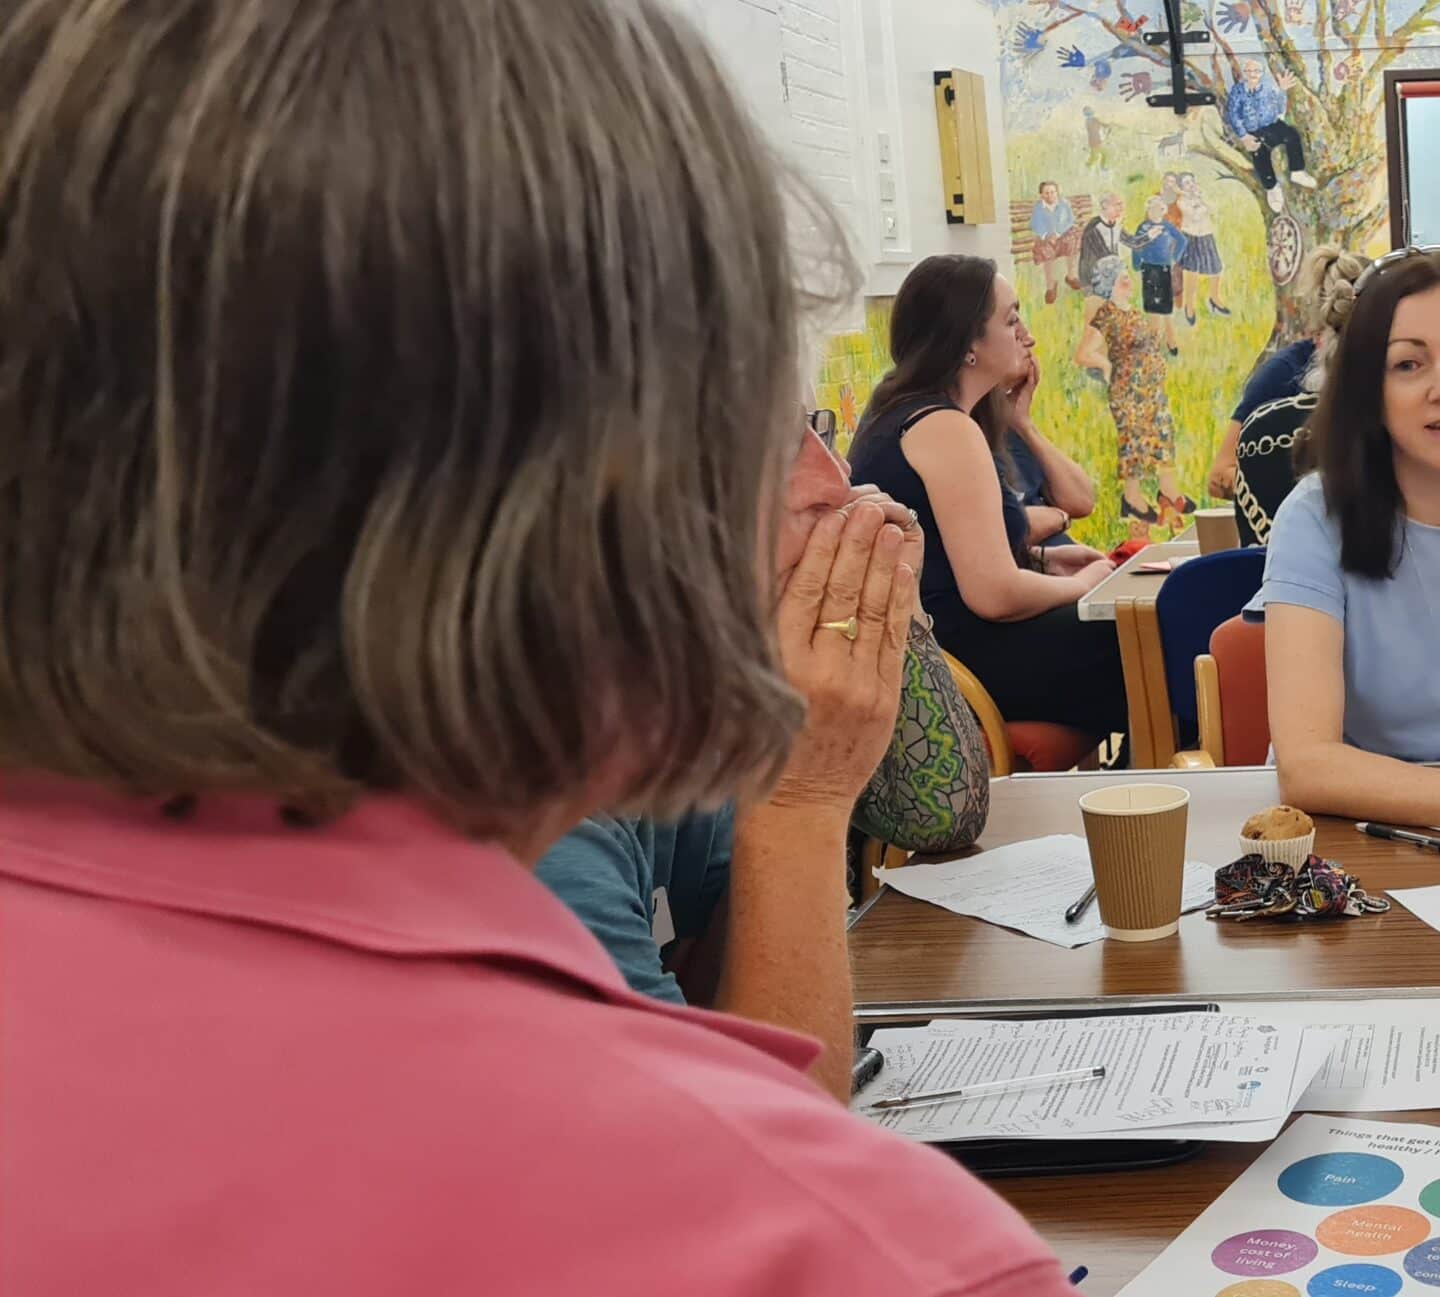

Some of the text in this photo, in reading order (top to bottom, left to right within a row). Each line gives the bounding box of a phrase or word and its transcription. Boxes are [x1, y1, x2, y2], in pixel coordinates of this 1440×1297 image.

[1328, 1128, 1372, 1140] Things
[1376, 1133, 1405, 1143] that
[1407, 1137, 1431, 1147] get
[1367, 1141, 1422, 1156] healthy
[1324, 1173, 1357, 1184] Pain
[1351, 1220, 1402, 1232] Mental
[1345, 1229, 1393, 1241] health
[1239, 1248, 1292, 1258] cost of
[1235, 1257, 1276, 1270] living
[1333, 1279, 1377, 1293] Sleep
